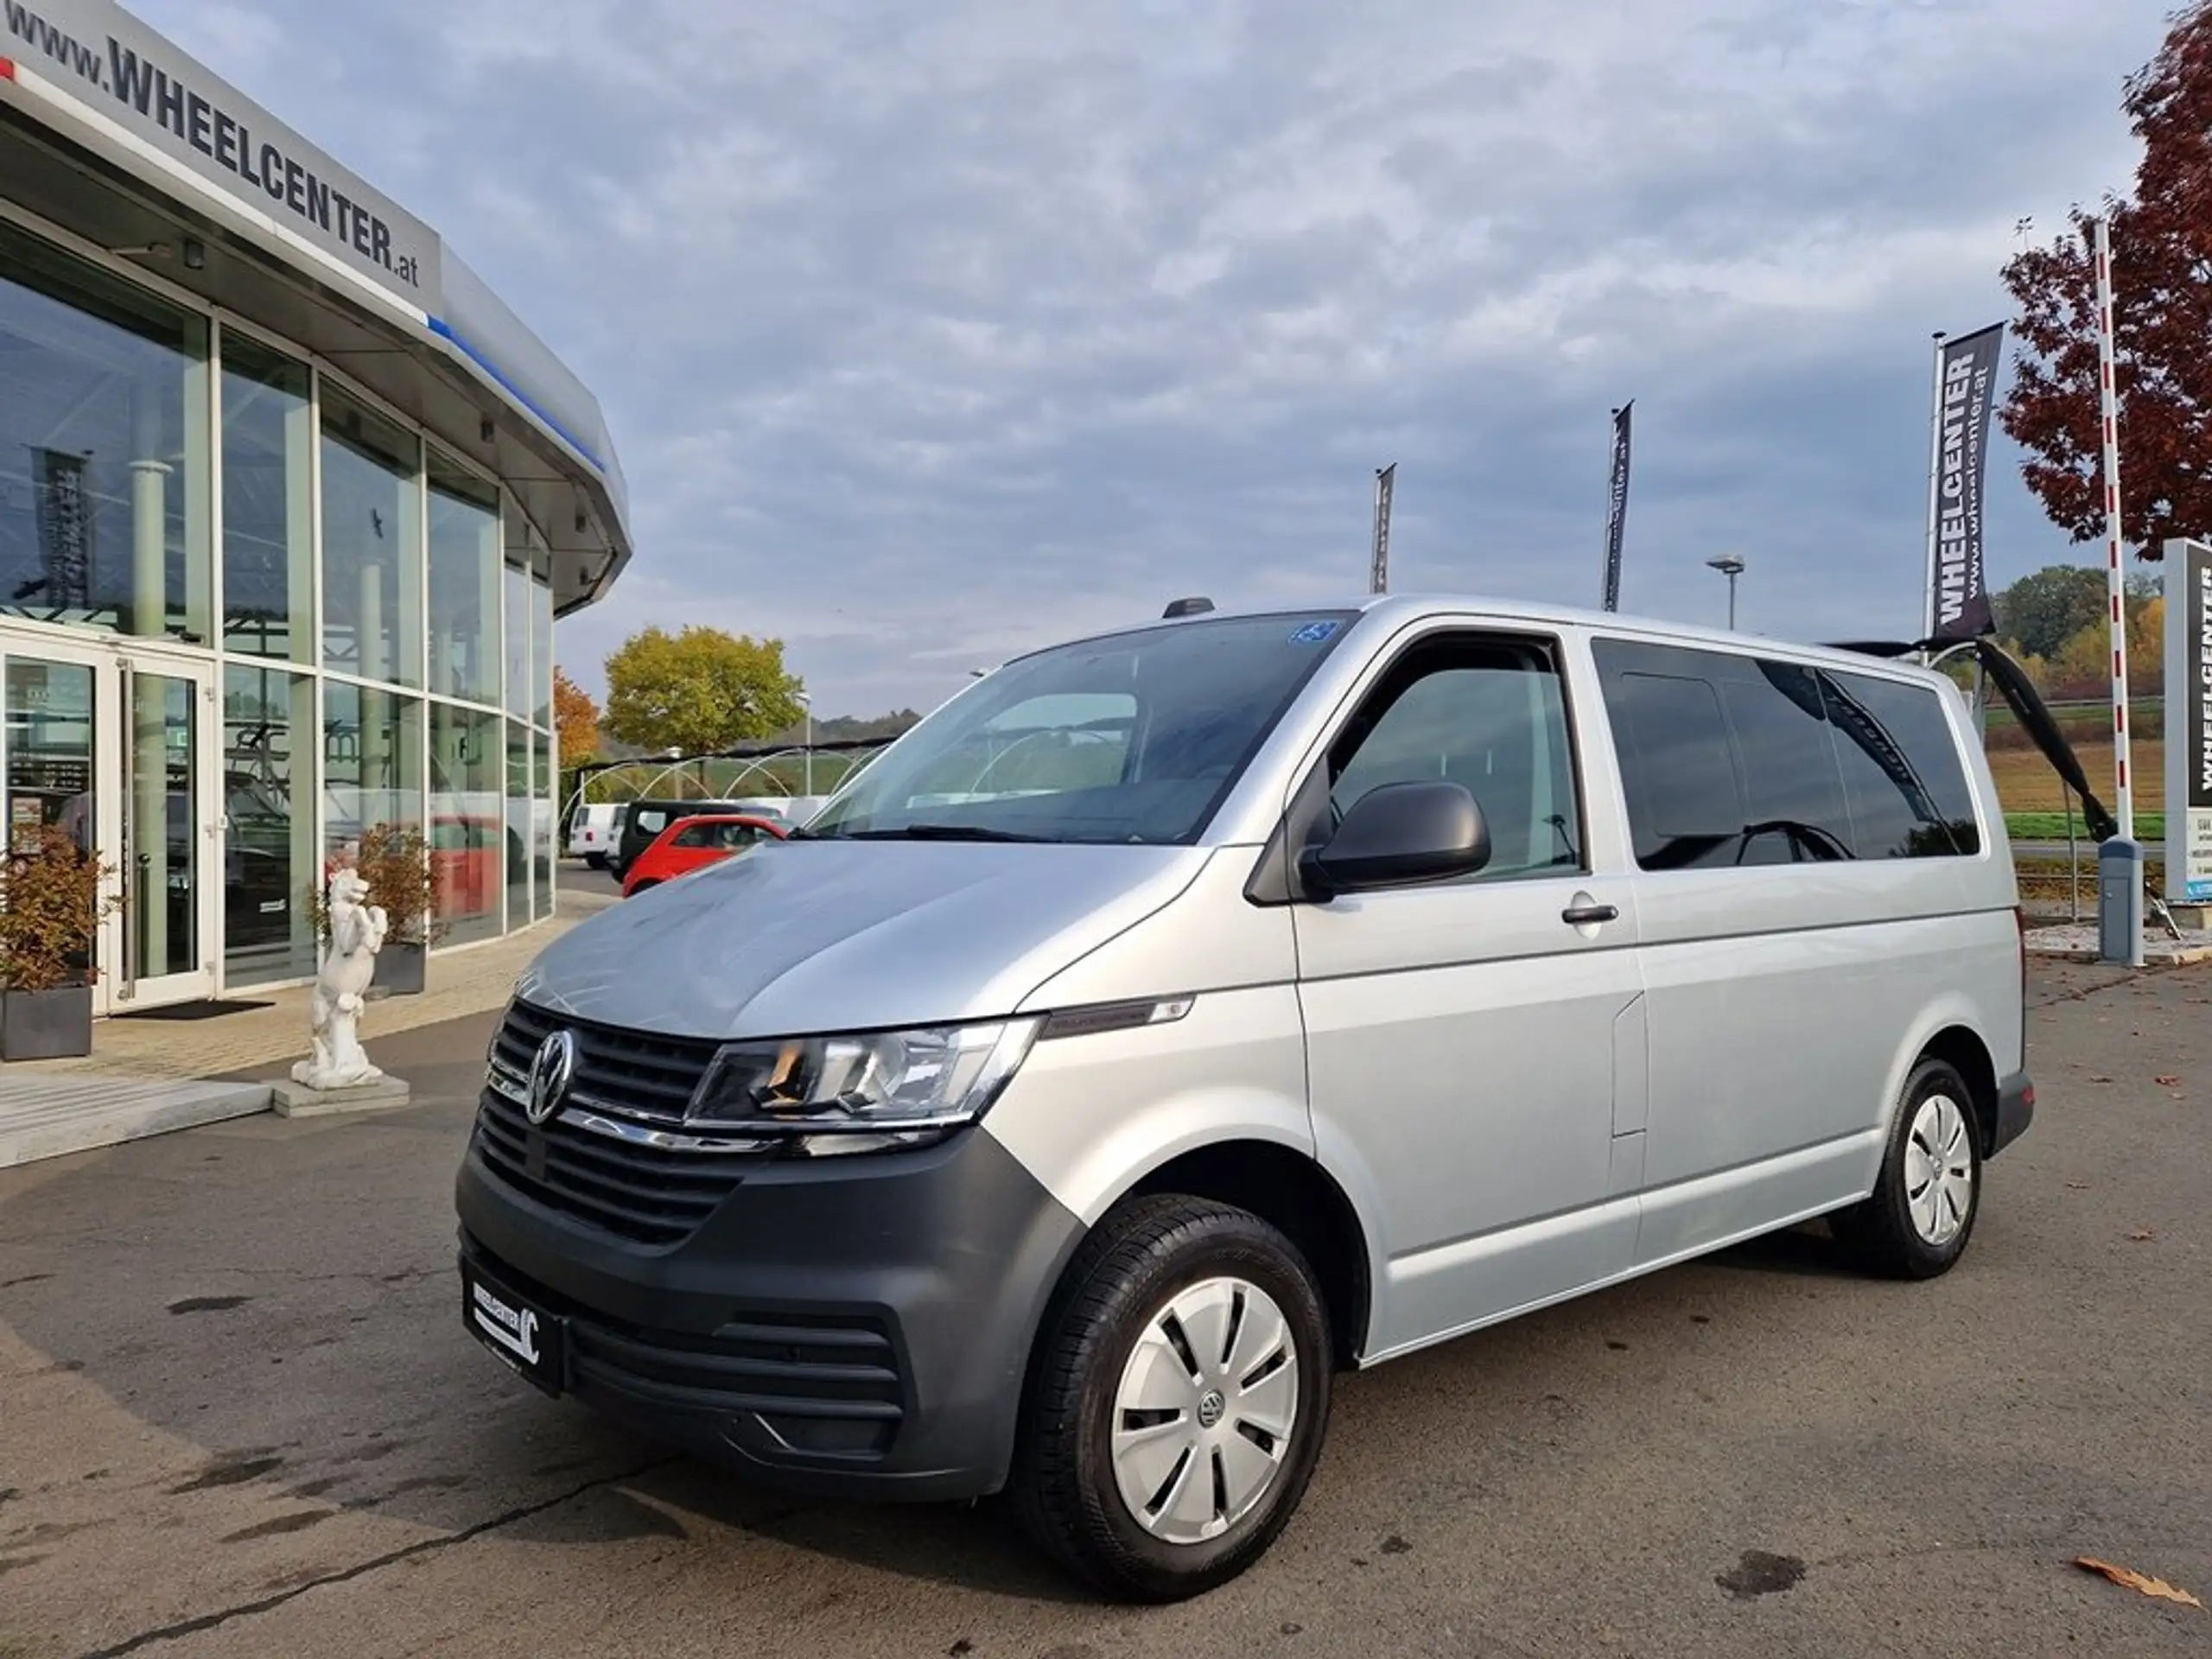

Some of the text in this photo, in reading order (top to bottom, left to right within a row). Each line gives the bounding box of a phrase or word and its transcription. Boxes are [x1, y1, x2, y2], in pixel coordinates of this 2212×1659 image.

[3, 0, 419, 288] www.WHEELCENTER.at
[1940, 351, 1974, 626] WHEELCENTER
[1967, 365, 1990, 601] wwwwheelcenter.at
